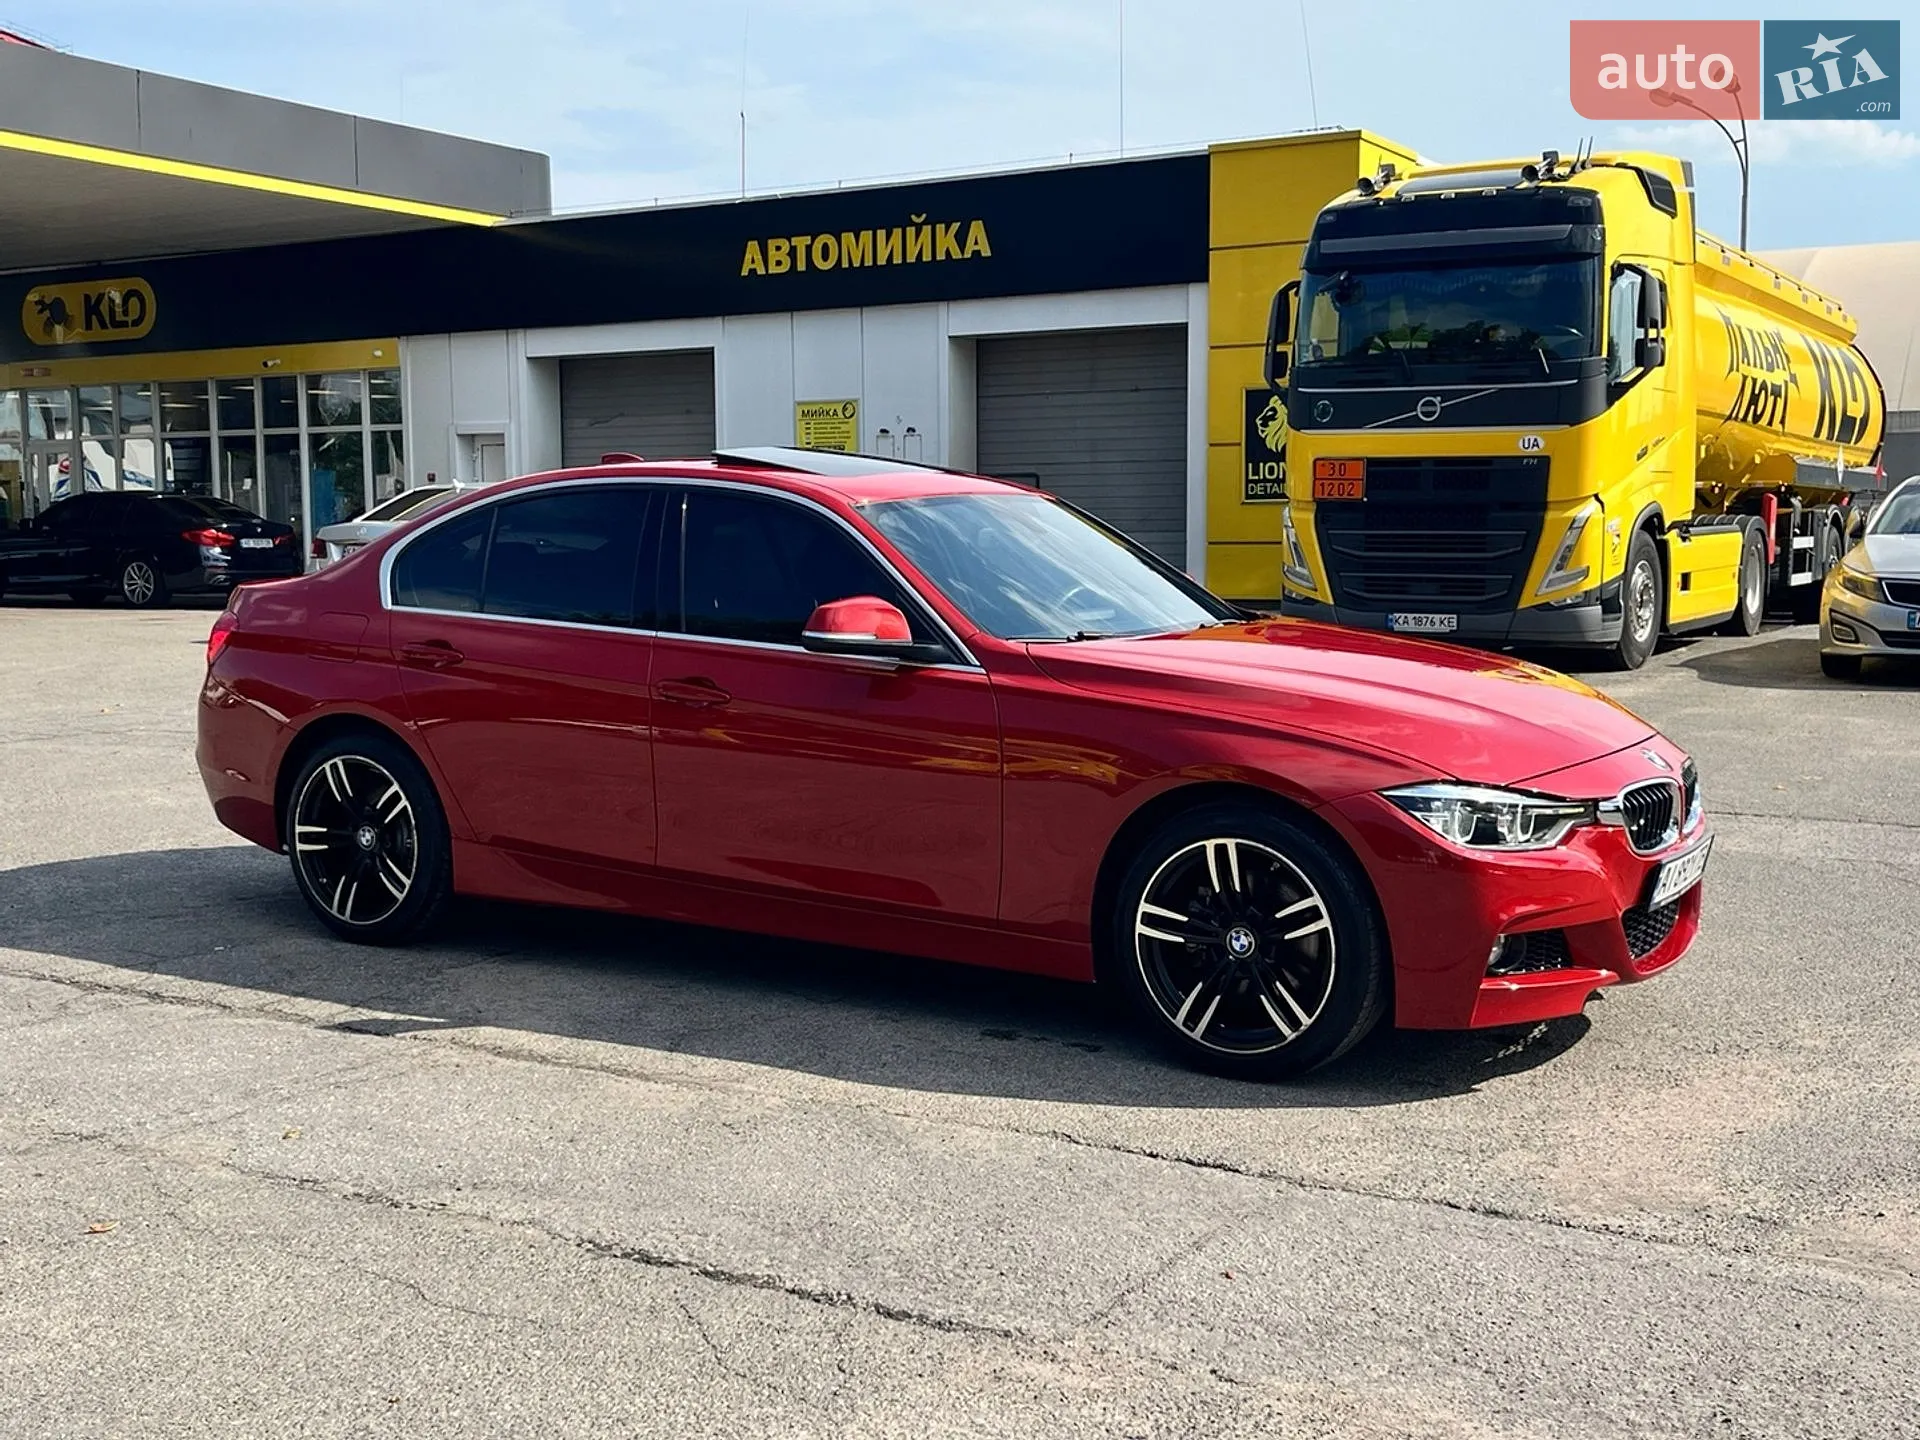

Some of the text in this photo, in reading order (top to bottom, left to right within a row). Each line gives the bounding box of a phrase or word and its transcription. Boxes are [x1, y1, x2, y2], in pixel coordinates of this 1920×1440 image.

[741, 213, 992, 276] АВТОМИЙКА
[802, 407, 839, 418] МИЙКА
[1522, 438, 1540, 450] UA
[1327, 463, 1347, 477] 30
[1320, 482, 1355, 497] 1202
[1439, 617, 1456, 628] KE
